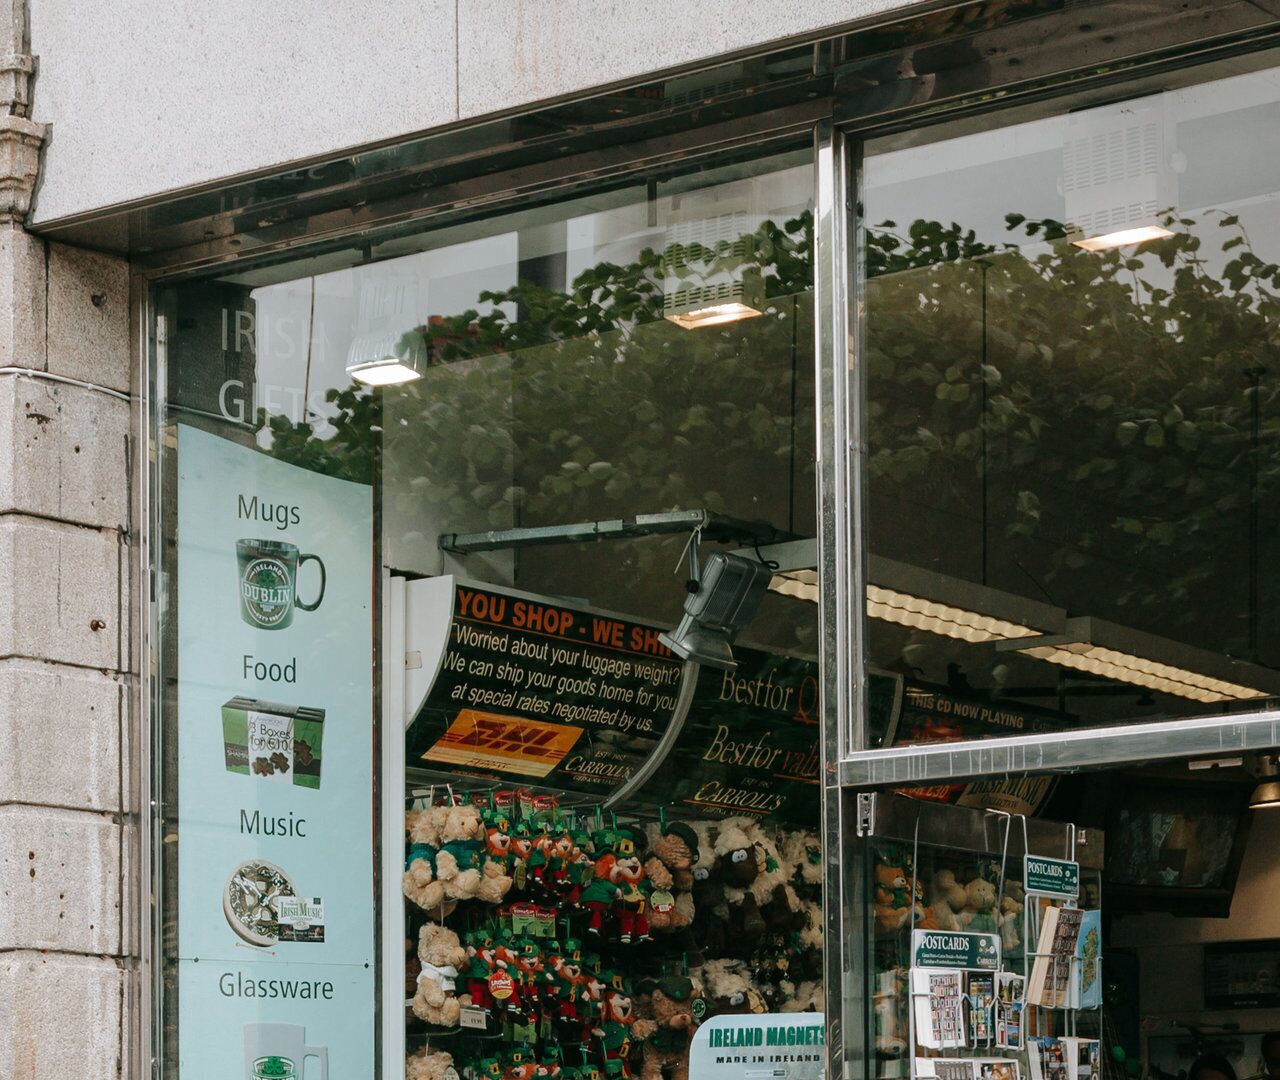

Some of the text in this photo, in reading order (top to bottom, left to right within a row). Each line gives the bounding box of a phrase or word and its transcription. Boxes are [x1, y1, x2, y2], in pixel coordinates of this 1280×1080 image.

[238, 494, 301, 530] Mugs
[243, 582, 290, 603] DUBLIN
[243, 655, 296, 683] Food
[452, 683, 468, 699] at
[468, 686, 515, 709] special
[517, 695, 550, 715] rates
[551, 700, 618, 726] negotiated
[620, 713, 636, 732] by
[911, 696, 1024, 729] THIS CD NOW PLAYING
[459, 719, 558, 756] DHL
[240, 809, 306, 837] Music
[1027, 861, 1063, 878] POSTCARDS
[921, 935, 969, 951] POSTCARDS
[219, 971, 333, 1000] Glassware
[709, 1027, 763, 1047] IRELAND
[716, 1055, 747, 1063] MADE
[770, 1054, 820, 1062] IRELAND
